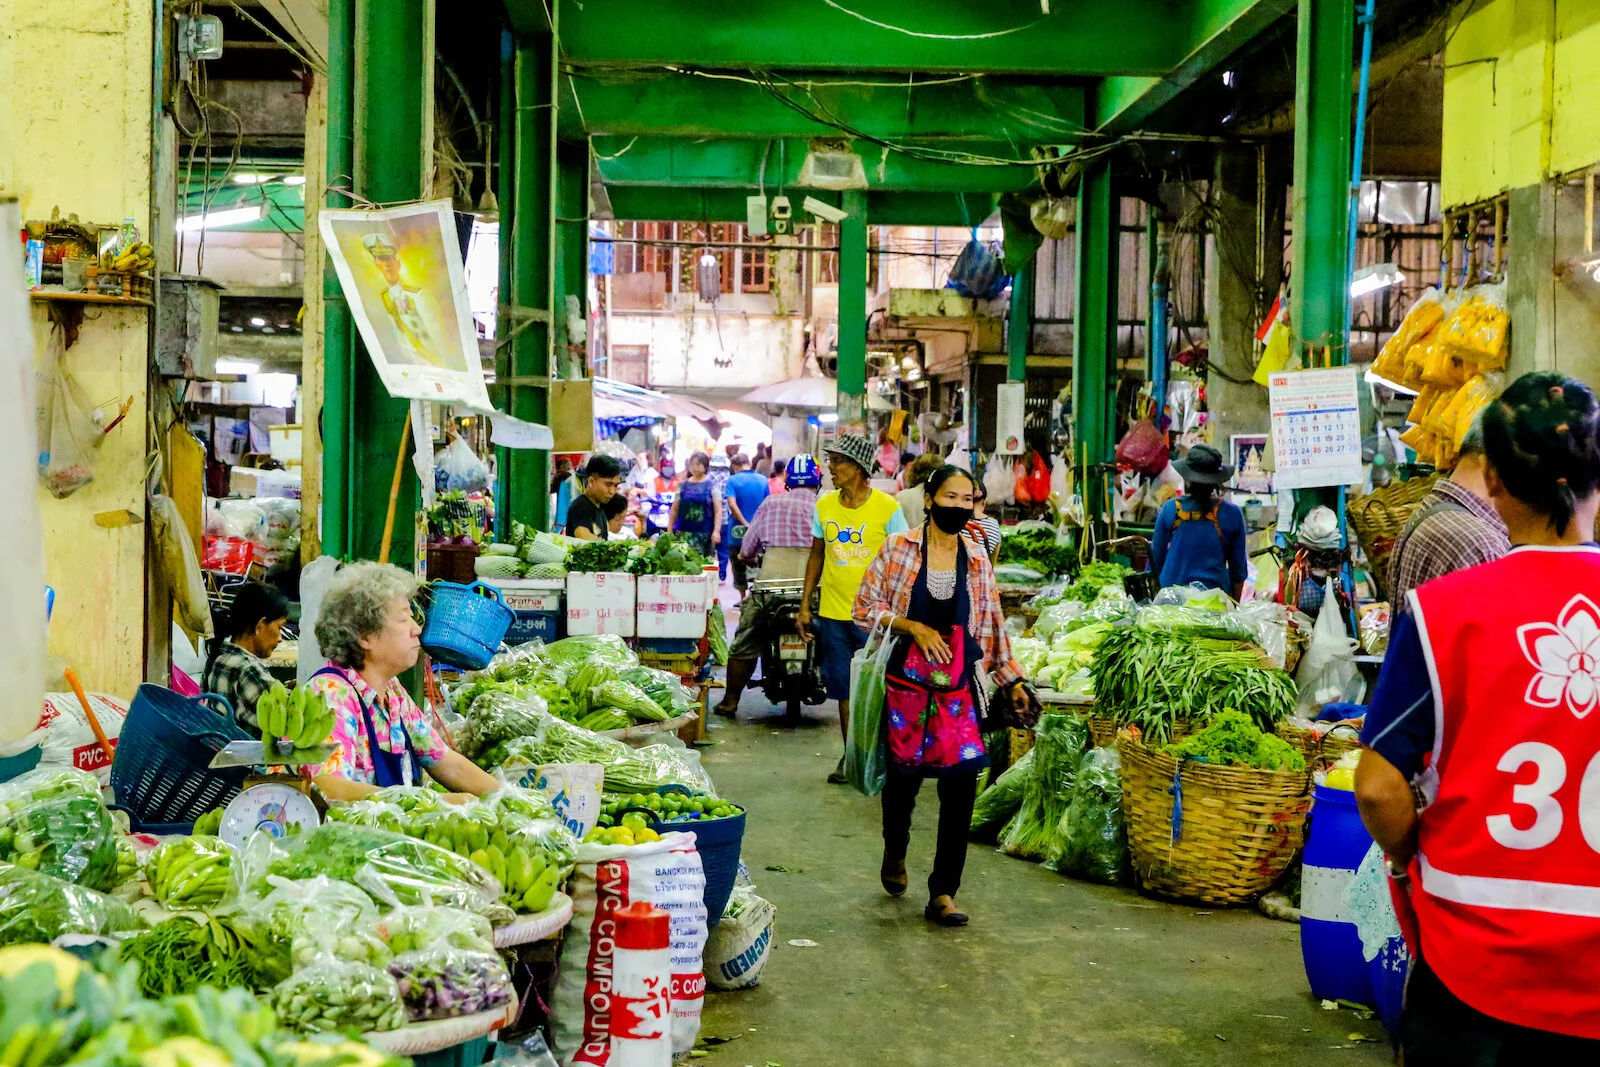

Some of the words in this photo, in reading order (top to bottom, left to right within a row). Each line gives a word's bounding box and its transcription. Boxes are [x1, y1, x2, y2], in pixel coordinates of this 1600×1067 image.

[79, 746, 104, 768] PVC
[1486, 742, 1600, 854] 3
[602, 863, 622, 912] PVC
[584, 920, 616, 1057] COMPOUND
